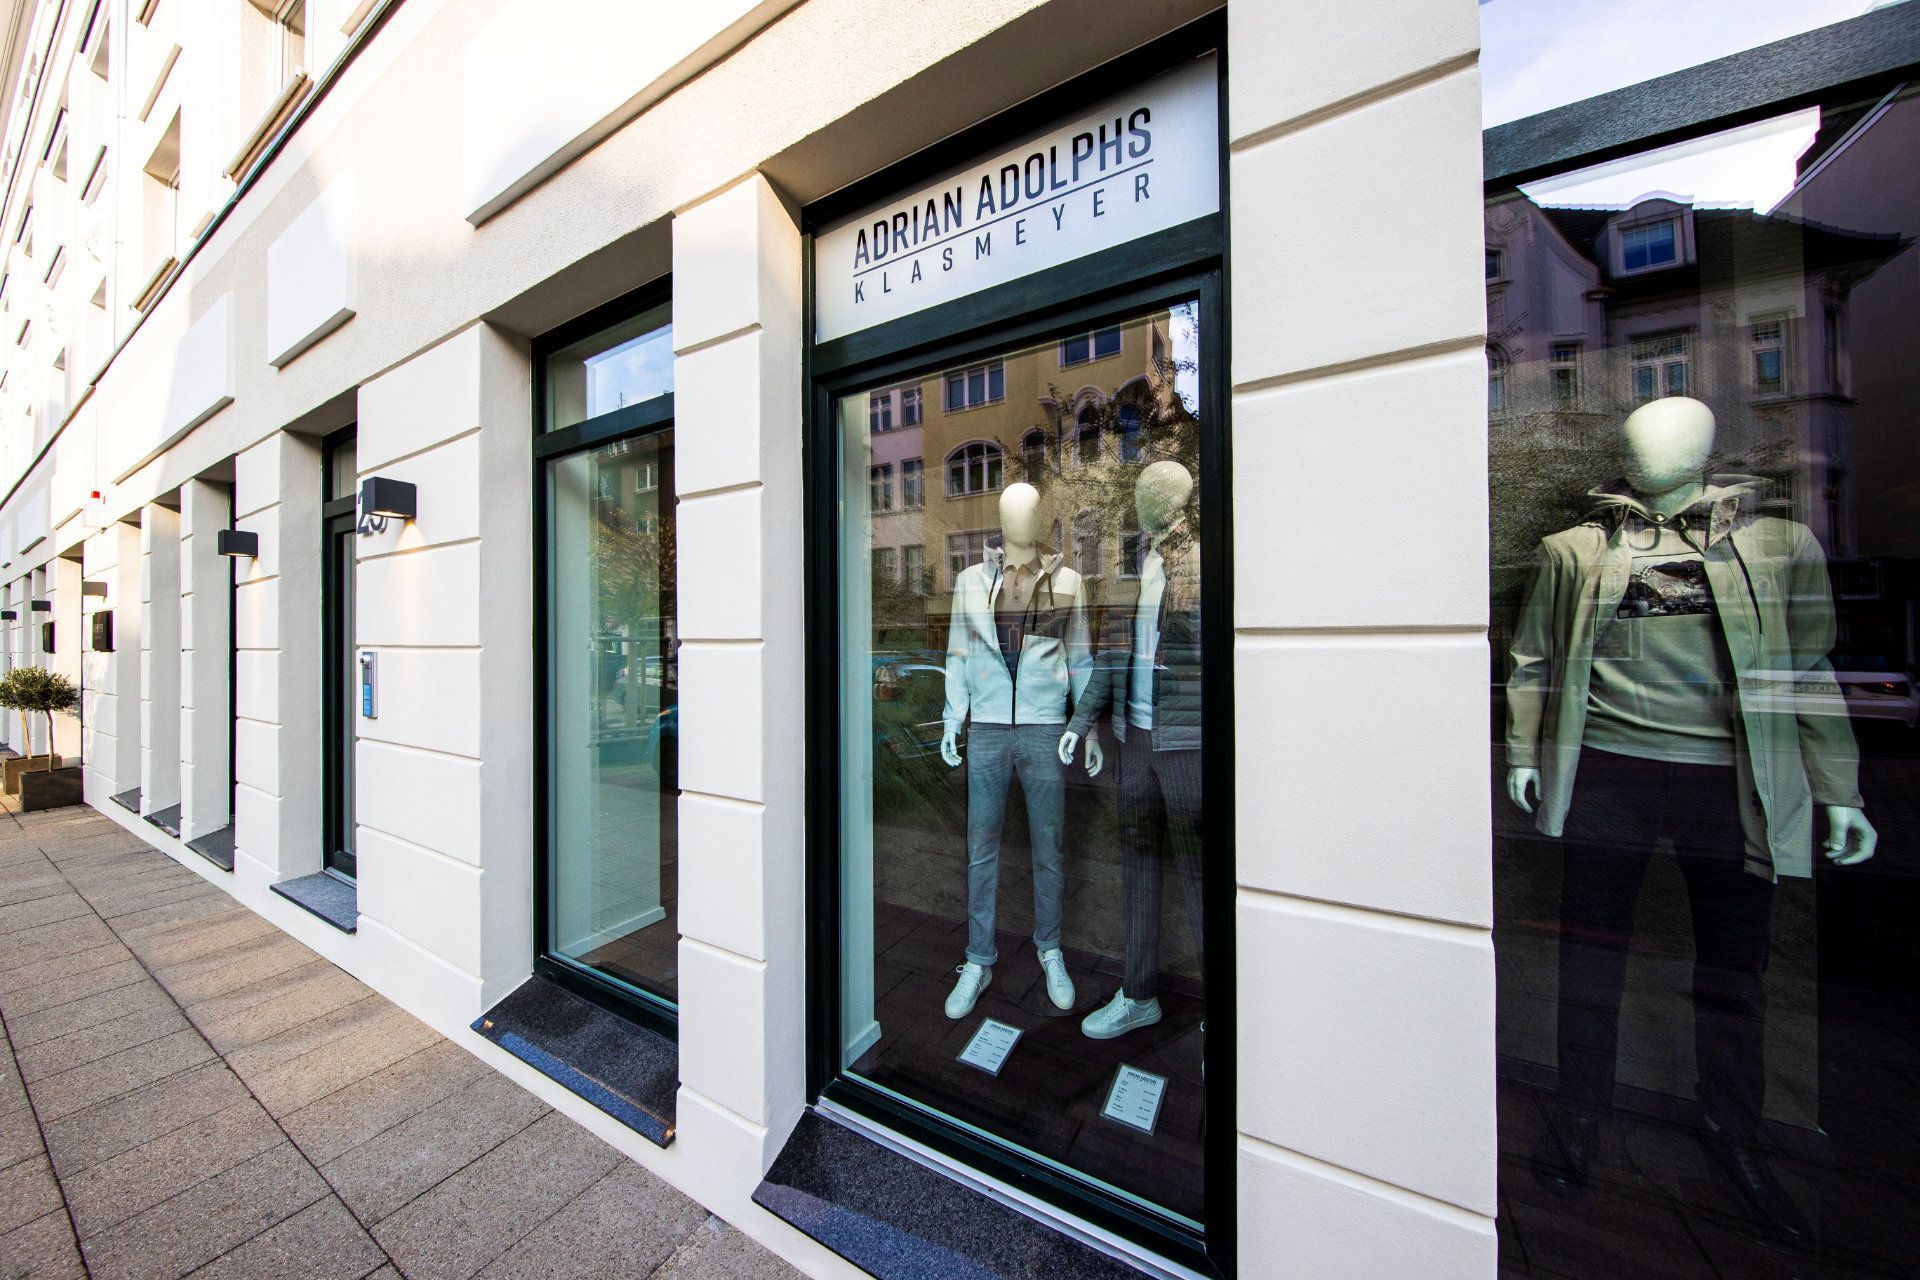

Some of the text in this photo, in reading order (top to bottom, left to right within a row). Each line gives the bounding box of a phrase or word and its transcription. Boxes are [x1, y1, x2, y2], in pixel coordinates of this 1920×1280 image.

[853, 107, 1151, 270] ADRIAN ADOLPHS
[854, 172, 1151, 304] KLASMEYER
